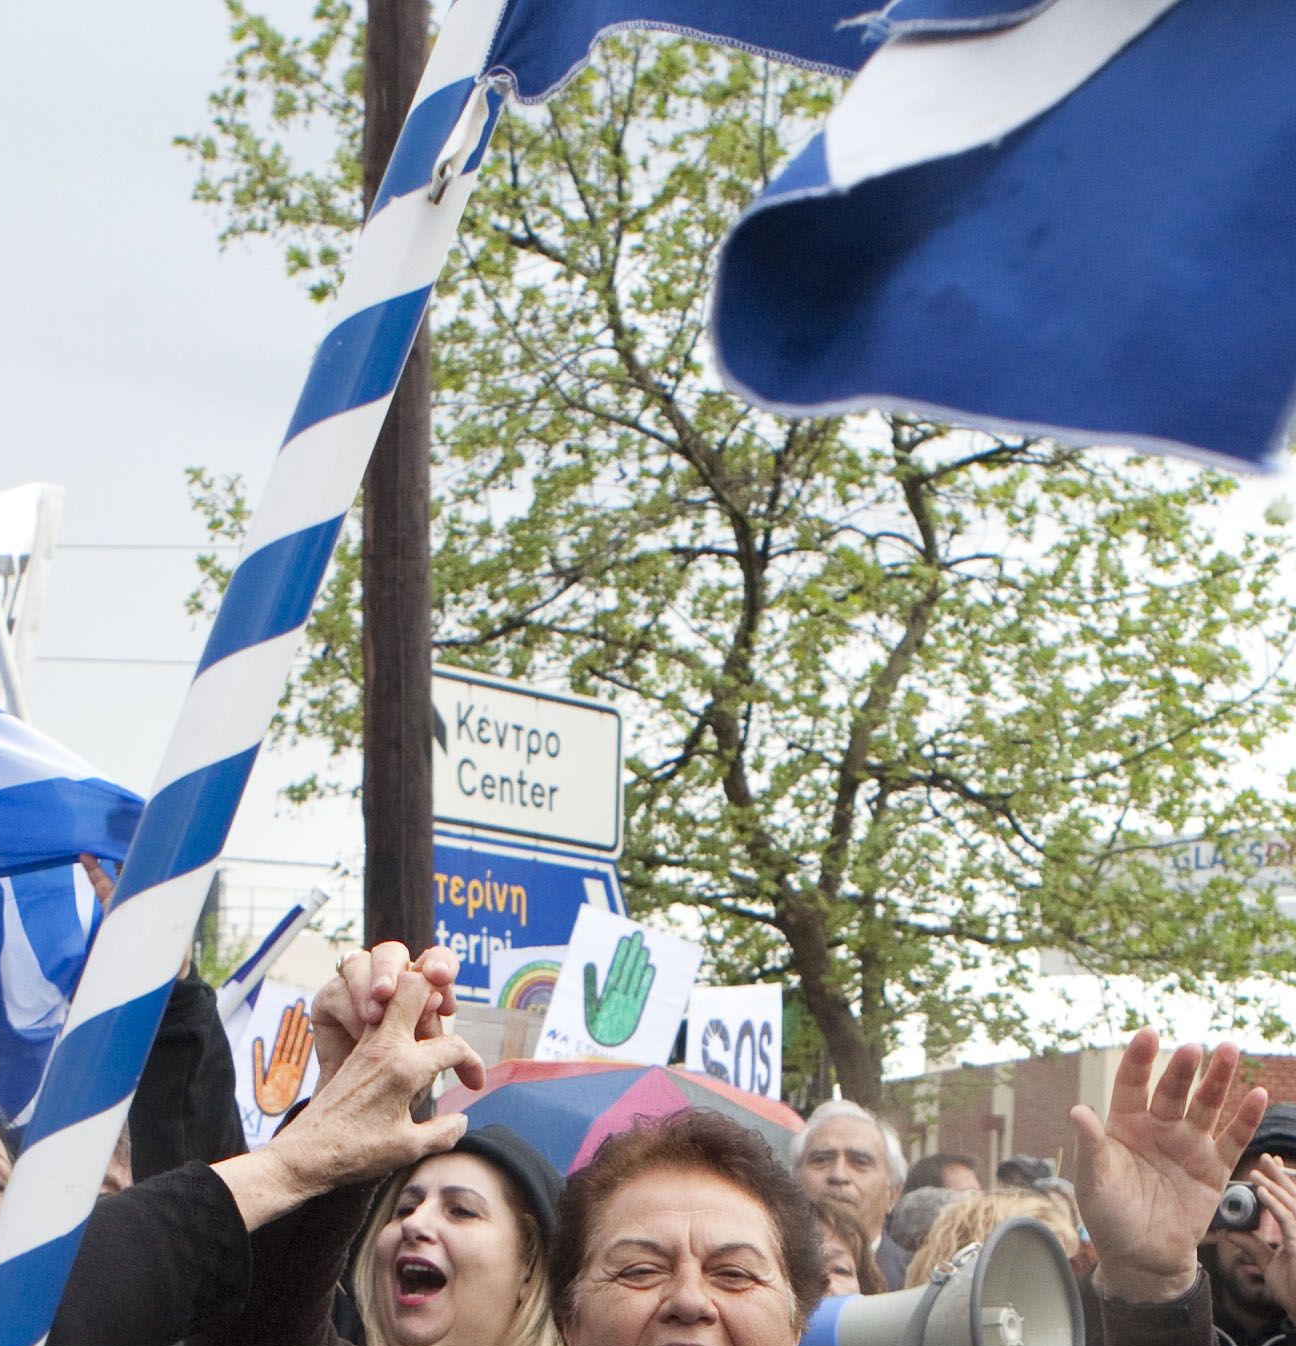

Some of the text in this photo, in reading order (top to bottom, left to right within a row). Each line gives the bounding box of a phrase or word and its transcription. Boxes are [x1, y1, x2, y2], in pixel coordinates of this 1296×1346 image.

[456, 701, 561, 764] Κέντρο
[457, 758, 559, 812] Center
[702, 1018, 773, 1098] SOS
